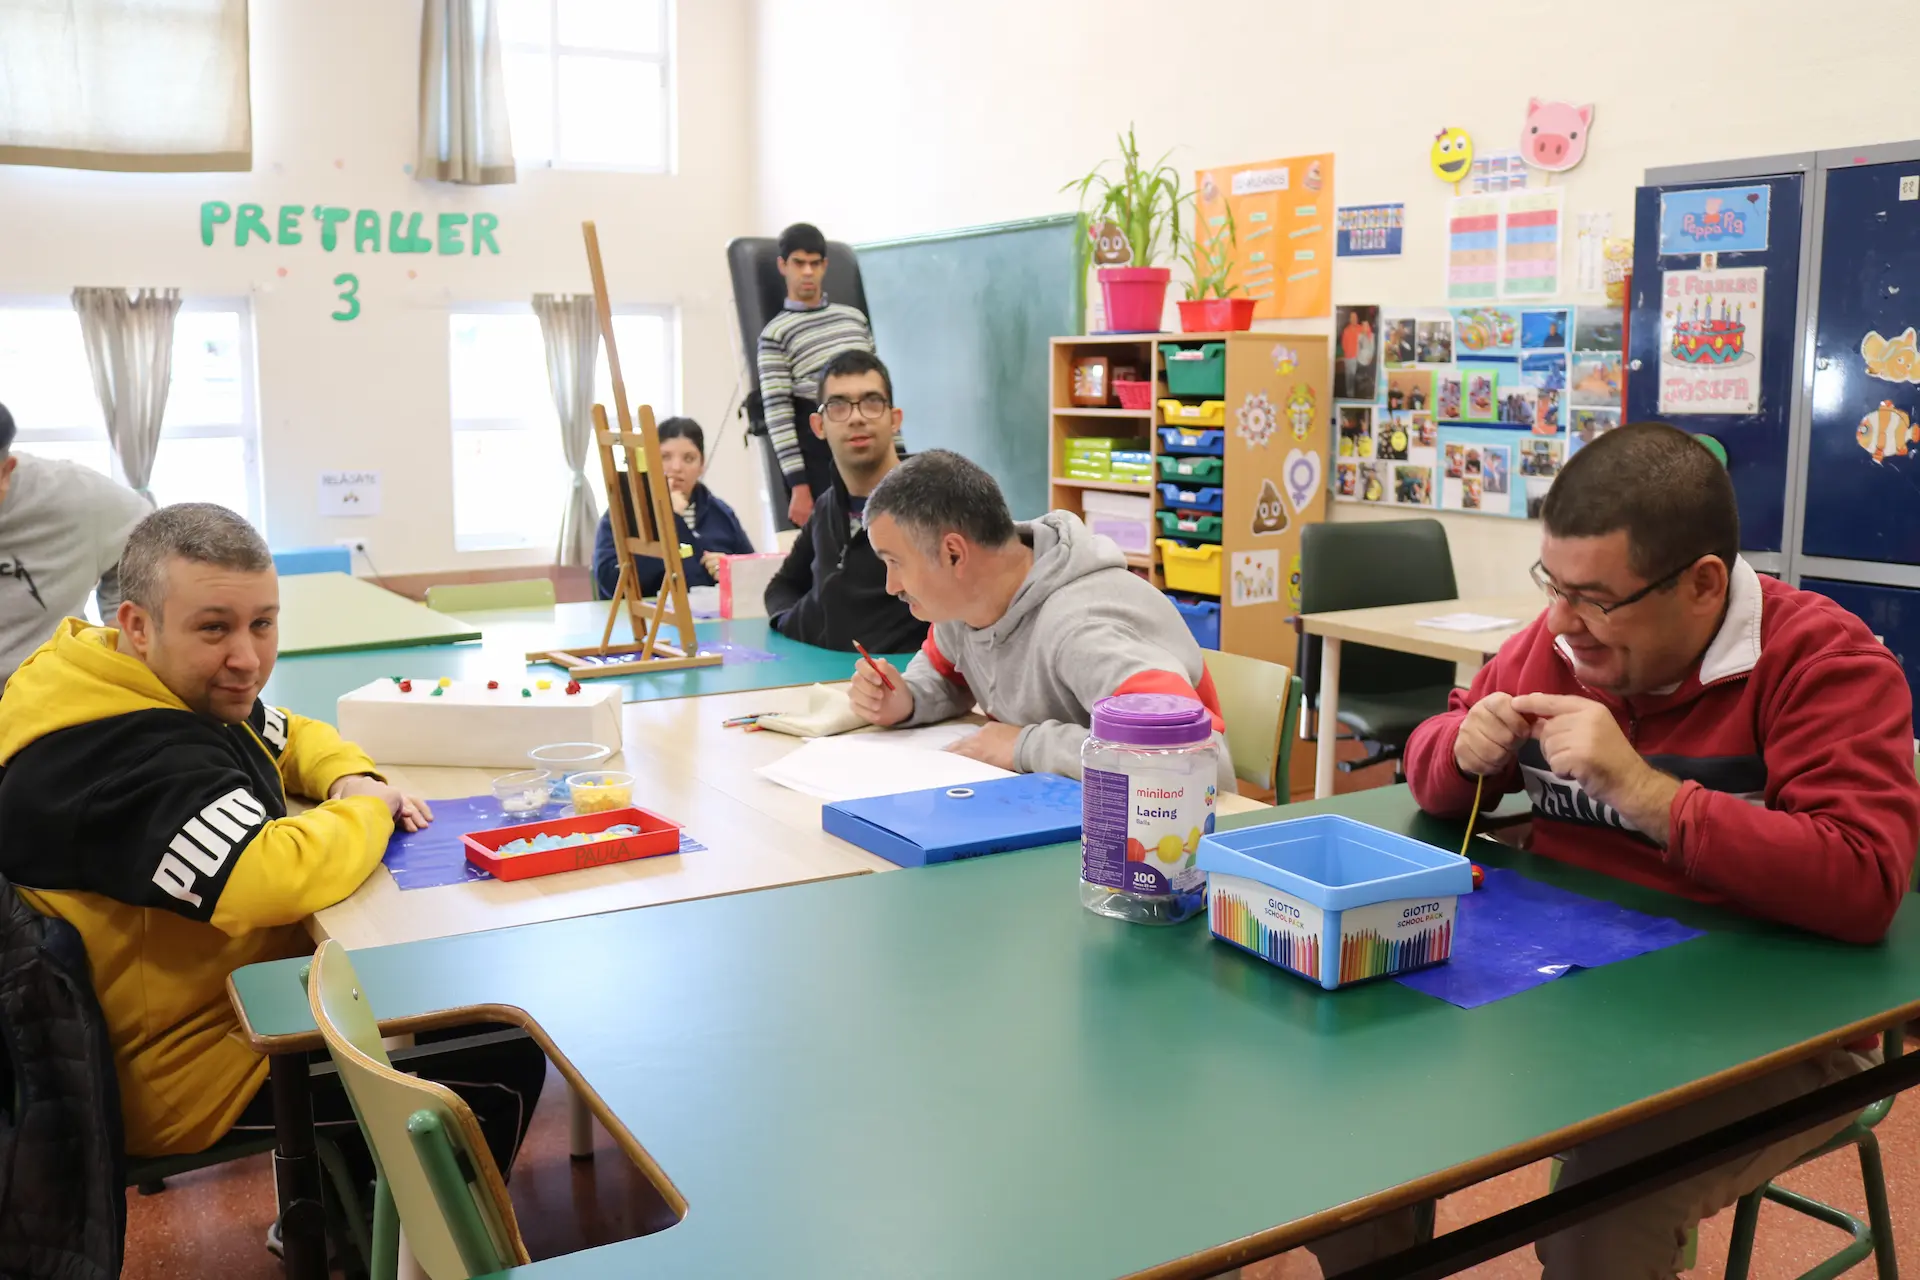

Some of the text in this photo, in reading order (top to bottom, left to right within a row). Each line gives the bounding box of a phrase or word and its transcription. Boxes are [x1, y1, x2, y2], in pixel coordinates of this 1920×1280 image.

[1683, 211, 1745, 241] Peppa Pig
[1666, 275, 1681, 298] 2
[331, 272, 361, 321] 3
[1136, 787, 1184, 799] miniland
[1136, 805, 1178, 820] Lacing
[1133, 871, 1156, 884] 100
[1268, 898, 1300, 918] GIOTTO
[1403, 902, 1439, 918] GIOTTO
[1264, 908, 1305, 930] SCHOOL PACK
[1397, 912, 1443, 928] SCHOOL PACK
